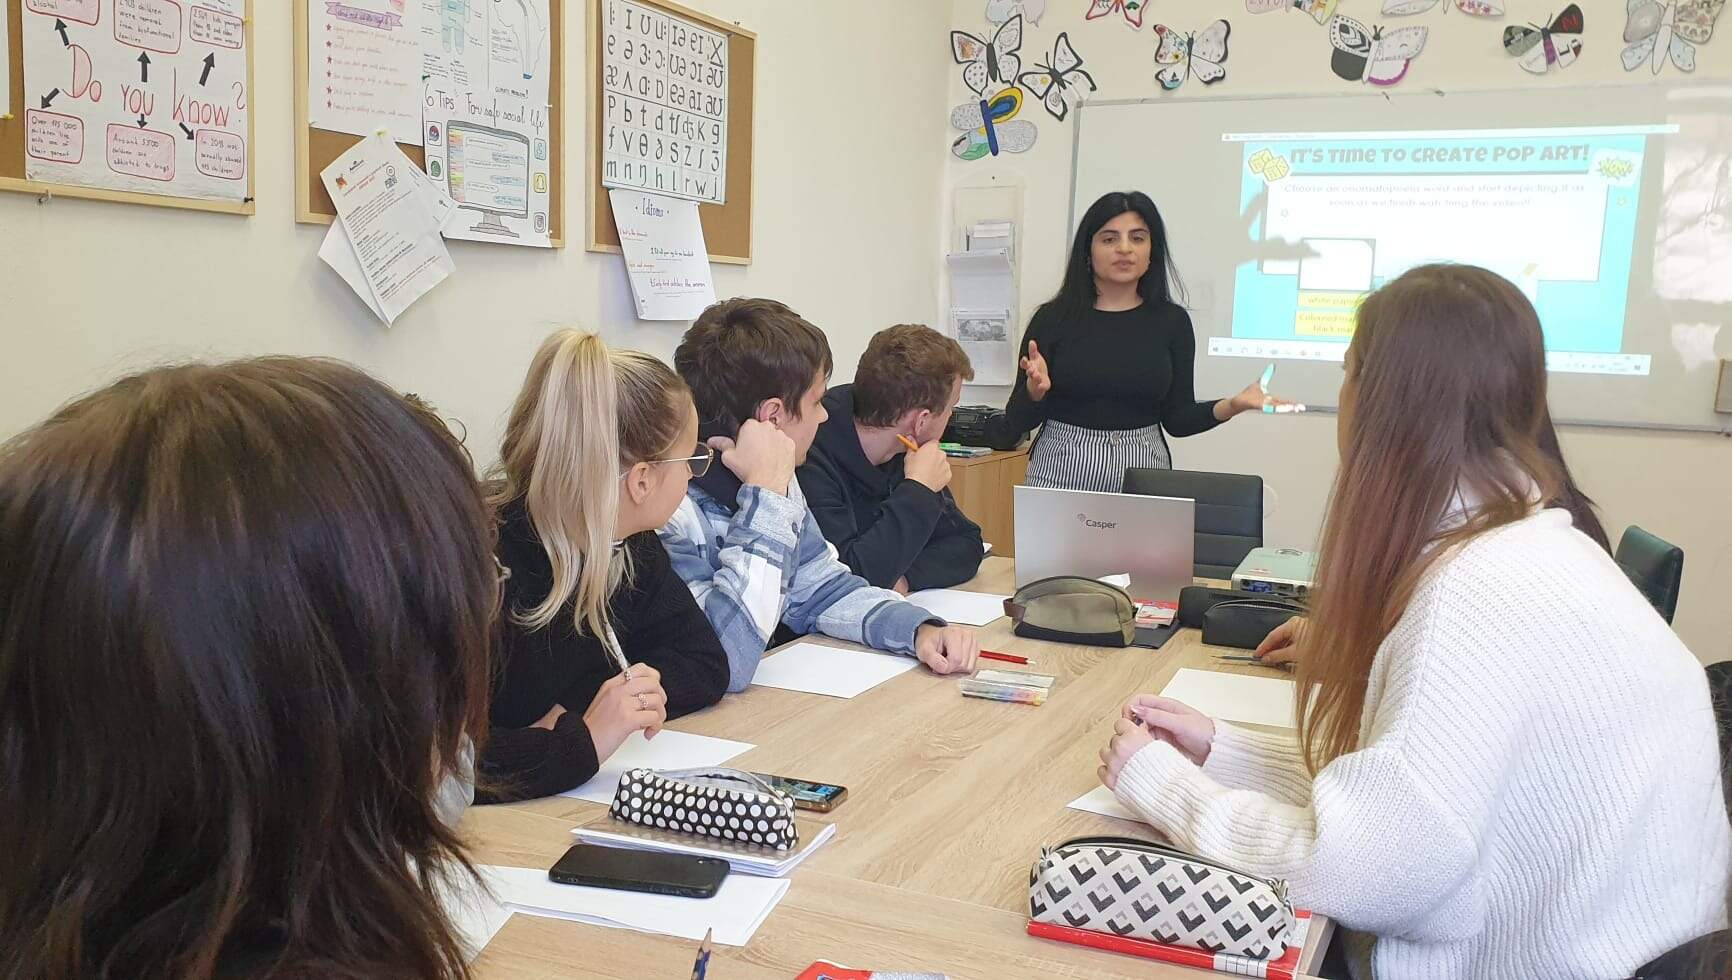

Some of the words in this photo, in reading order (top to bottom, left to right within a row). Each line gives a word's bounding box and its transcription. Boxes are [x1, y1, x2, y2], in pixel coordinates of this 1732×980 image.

[62, 44, 102, 102] Do
[1290, 147, 1324, 164] IT'S
[1381, 147, 1408, 163] TO
[1540, 144, 1590, 161] ART!
[1085, 519, 1117, 530] Casper
